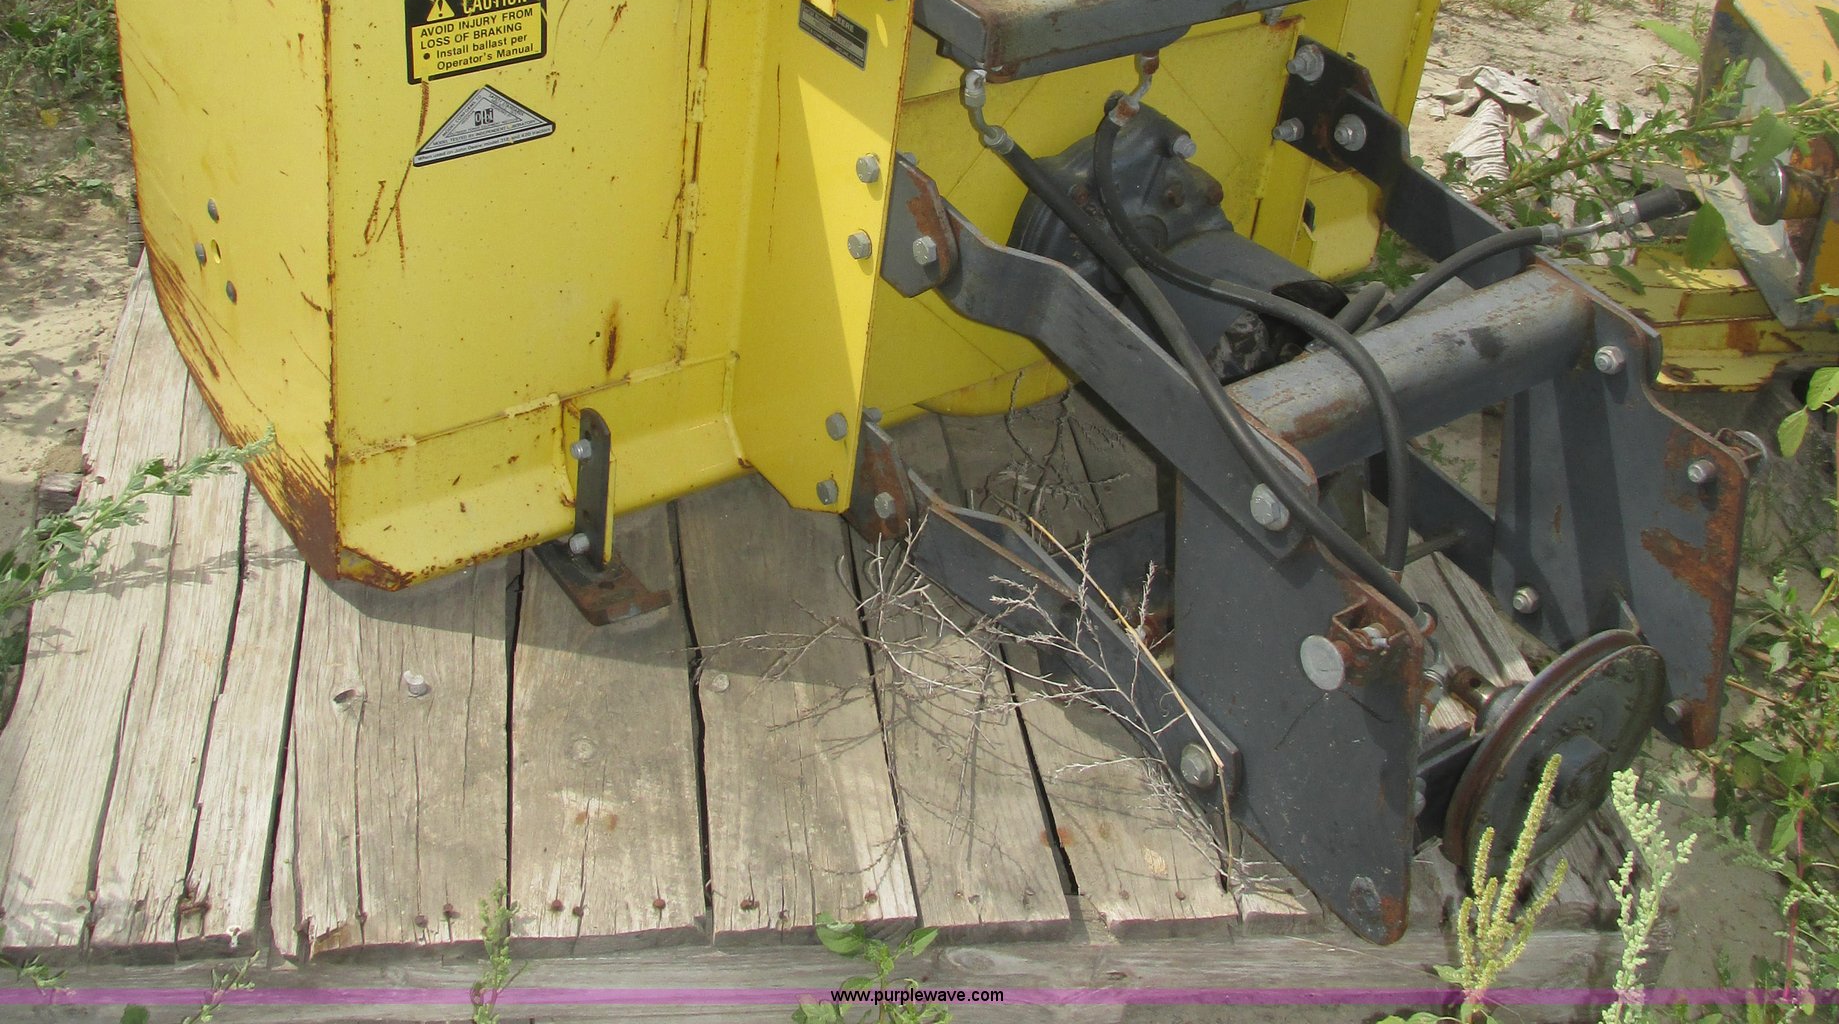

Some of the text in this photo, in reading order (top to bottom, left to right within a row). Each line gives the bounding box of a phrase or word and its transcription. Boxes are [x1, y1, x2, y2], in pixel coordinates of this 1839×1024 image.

[420, 7, 533, 38] AVOID INJURY FROM
[420, 22, 522, 50] LOSS OF BRAKING
[437, 34, 528, 59] Install ballast per
[437, 43, 534, 71] Operator's Manual
